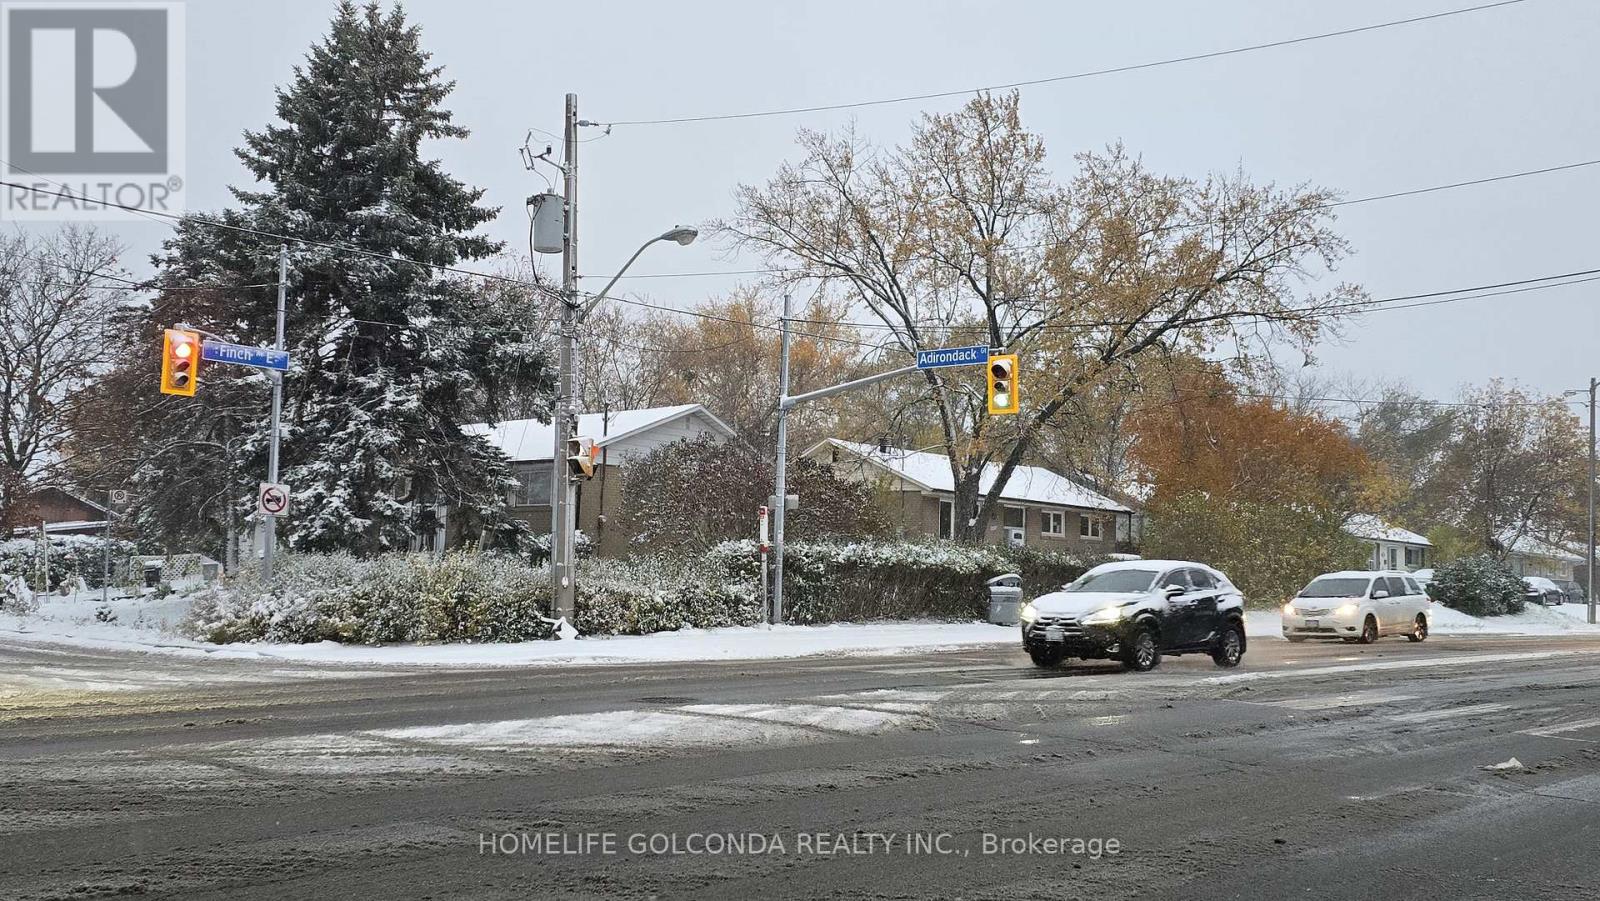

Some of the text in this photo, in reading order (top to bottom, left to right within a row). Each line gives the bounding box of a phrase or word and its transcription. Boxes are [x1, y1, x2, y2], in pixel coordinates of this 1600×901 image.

[219, 344, 252, 361] Finch
[265, 351, 273, 364] E
[919, 348, 977, 365] Adirondack
